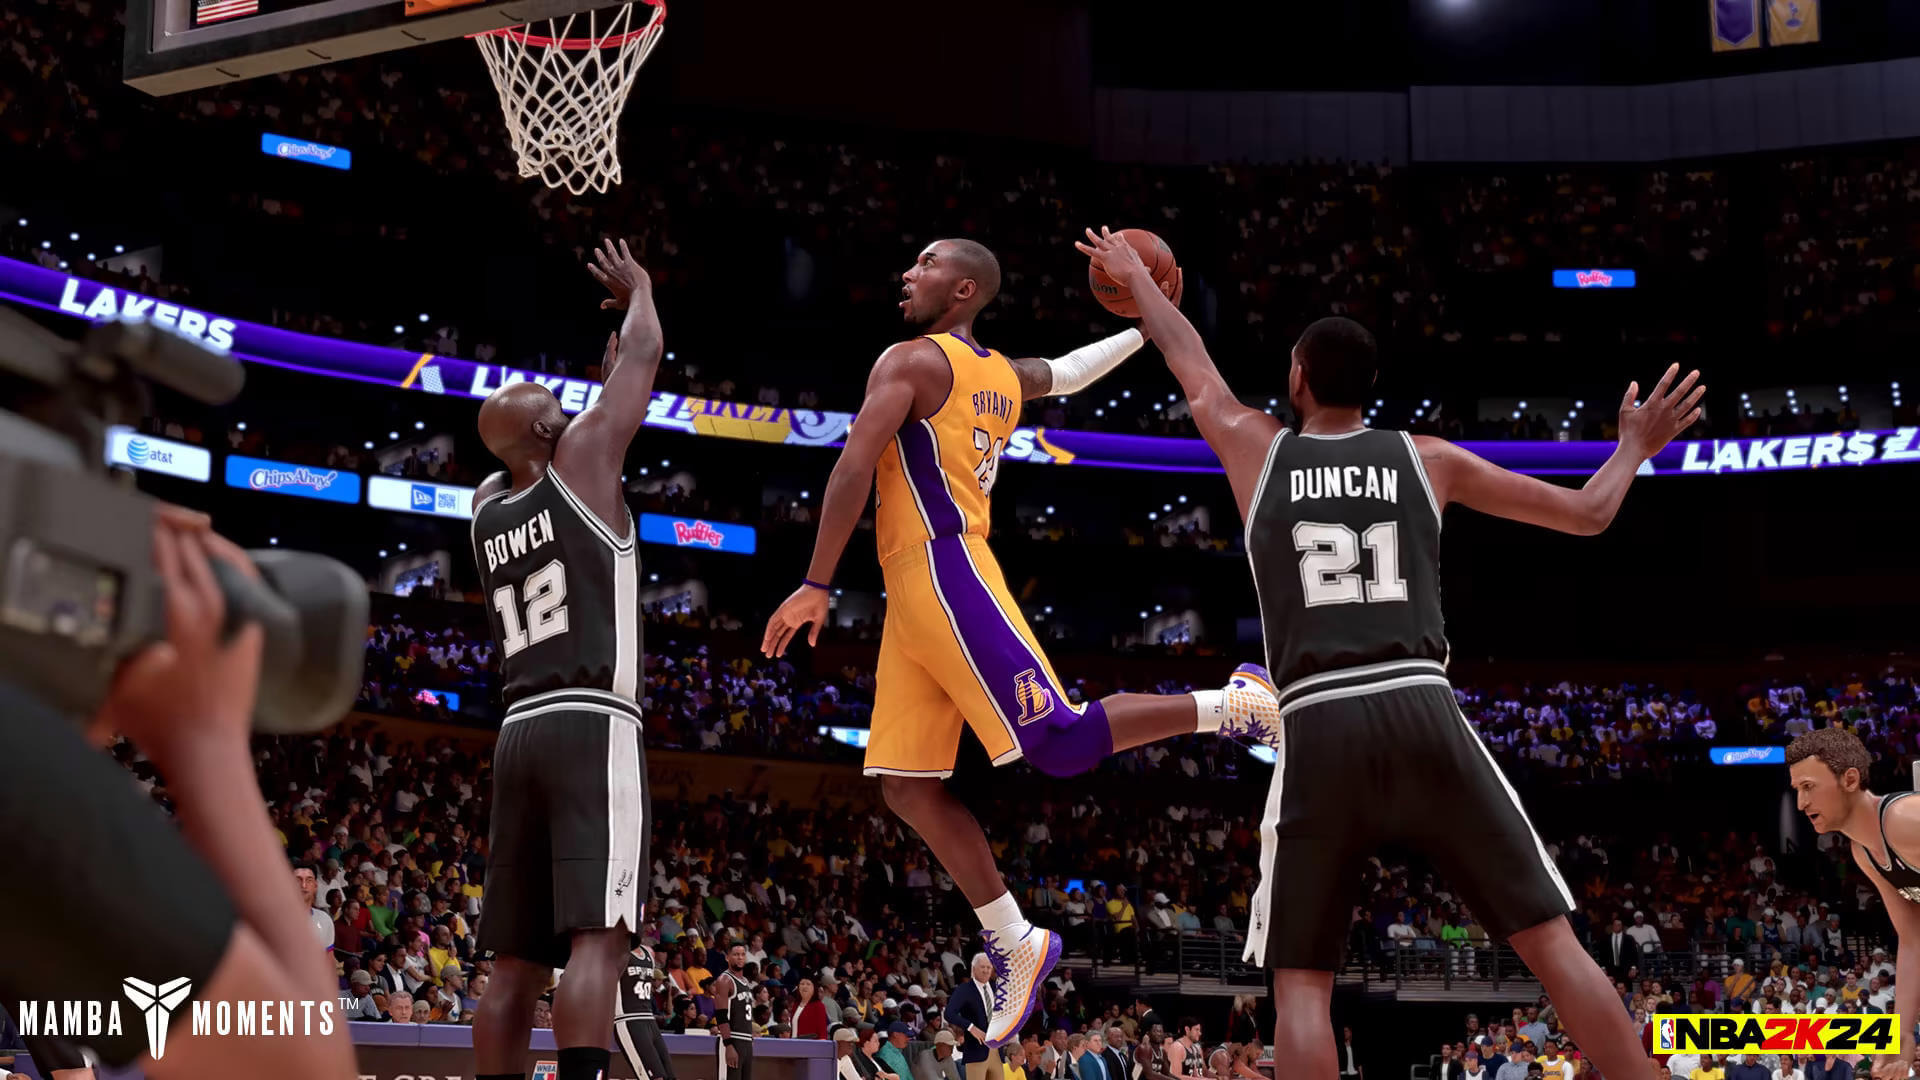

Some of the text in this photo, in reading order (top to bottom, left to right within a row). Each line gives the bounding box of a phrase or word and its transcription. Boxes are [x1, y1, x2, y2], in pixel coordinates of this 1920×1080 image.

[59, 277, 237, 354] LAKERS
[972, 390, 1013, 424] BRYANT
[149, 449, 173, 465] at&t
[1681, 432, 1877, 472] LAKERS
[250, 467, 292, 490] Chips
[1290, 465, 1398, 504] DUNCAN
[483, 508, 555, 573] BOWEN
[673, 519, 725, 549] Ruffles
[1291, 520, 1409, 608] 21
[493, 558, 569, 659] 12
[633, 981, 652, 1000] 40
